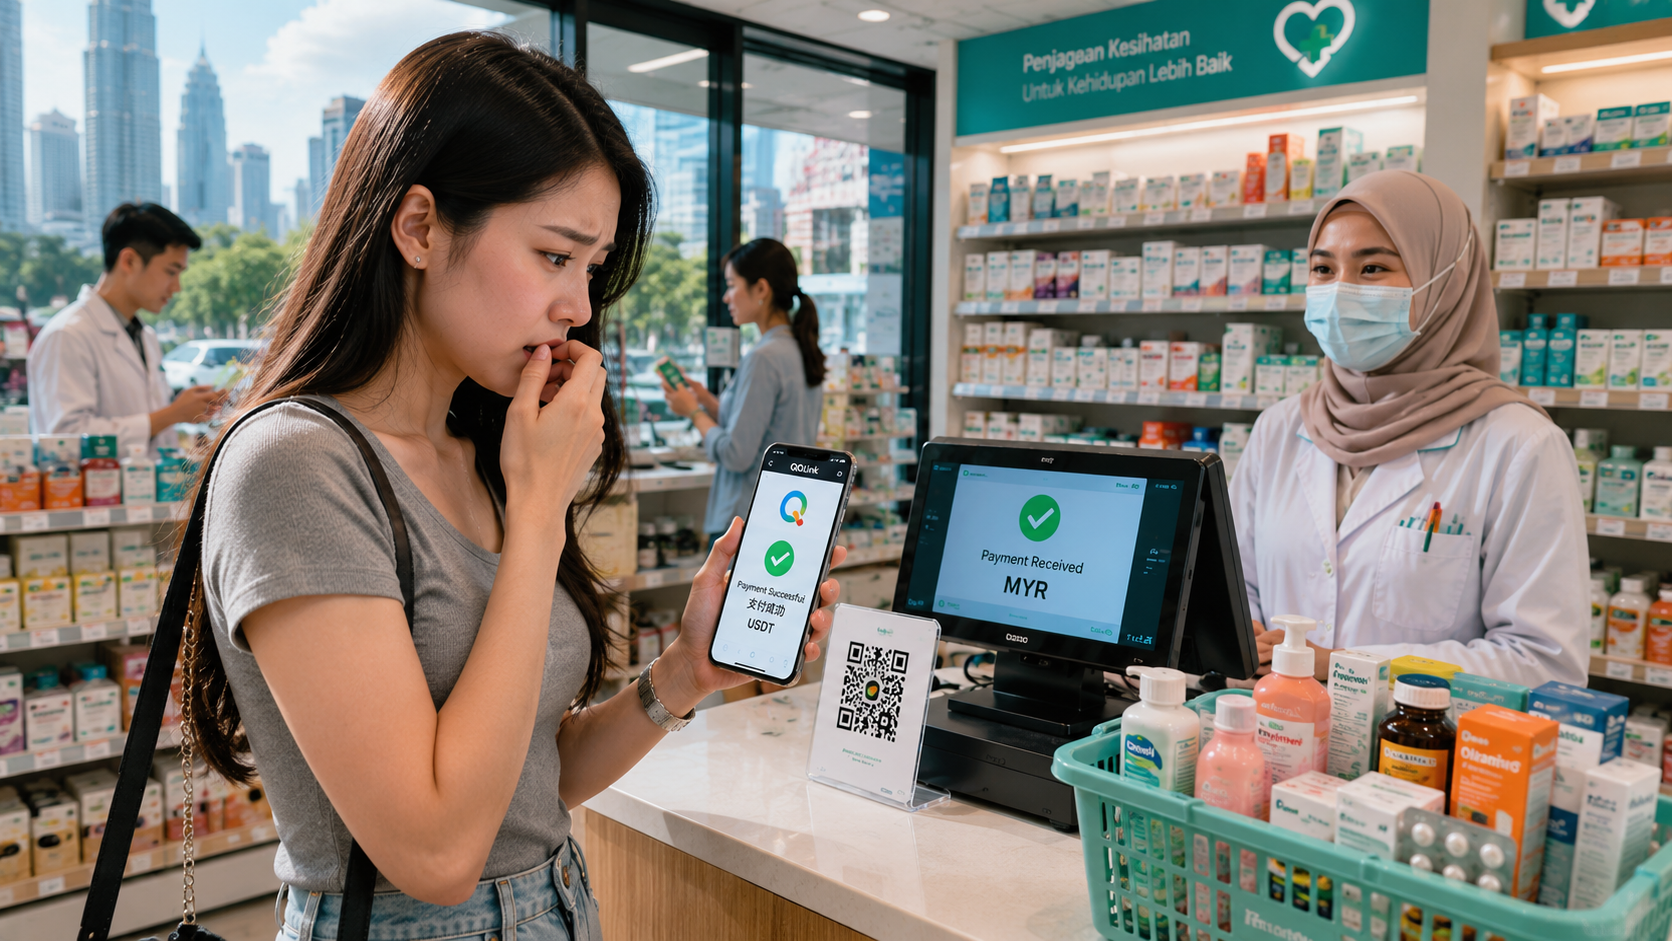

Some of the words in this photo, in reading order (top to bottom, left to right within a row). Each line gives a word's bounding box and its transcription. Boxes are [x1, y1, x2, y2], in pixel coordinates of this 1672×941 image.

[1108, 30, 1191, 59] Kesihatan
[1022, 78, 1065, 103] Untuk
[1067, 69, 1146, 93] Kehidupan
[1149, 57, 1193, 83] Lebih
[1195, 51, 1233, 77] Baik
[981, 549, 1030, 566] Payment
[1030, 555, 1084, 575] Received
[736, 580, 768, 595] Payment
[1003, 575, 1049, 600] MYR
[747, 618, 776, 634] USDT
